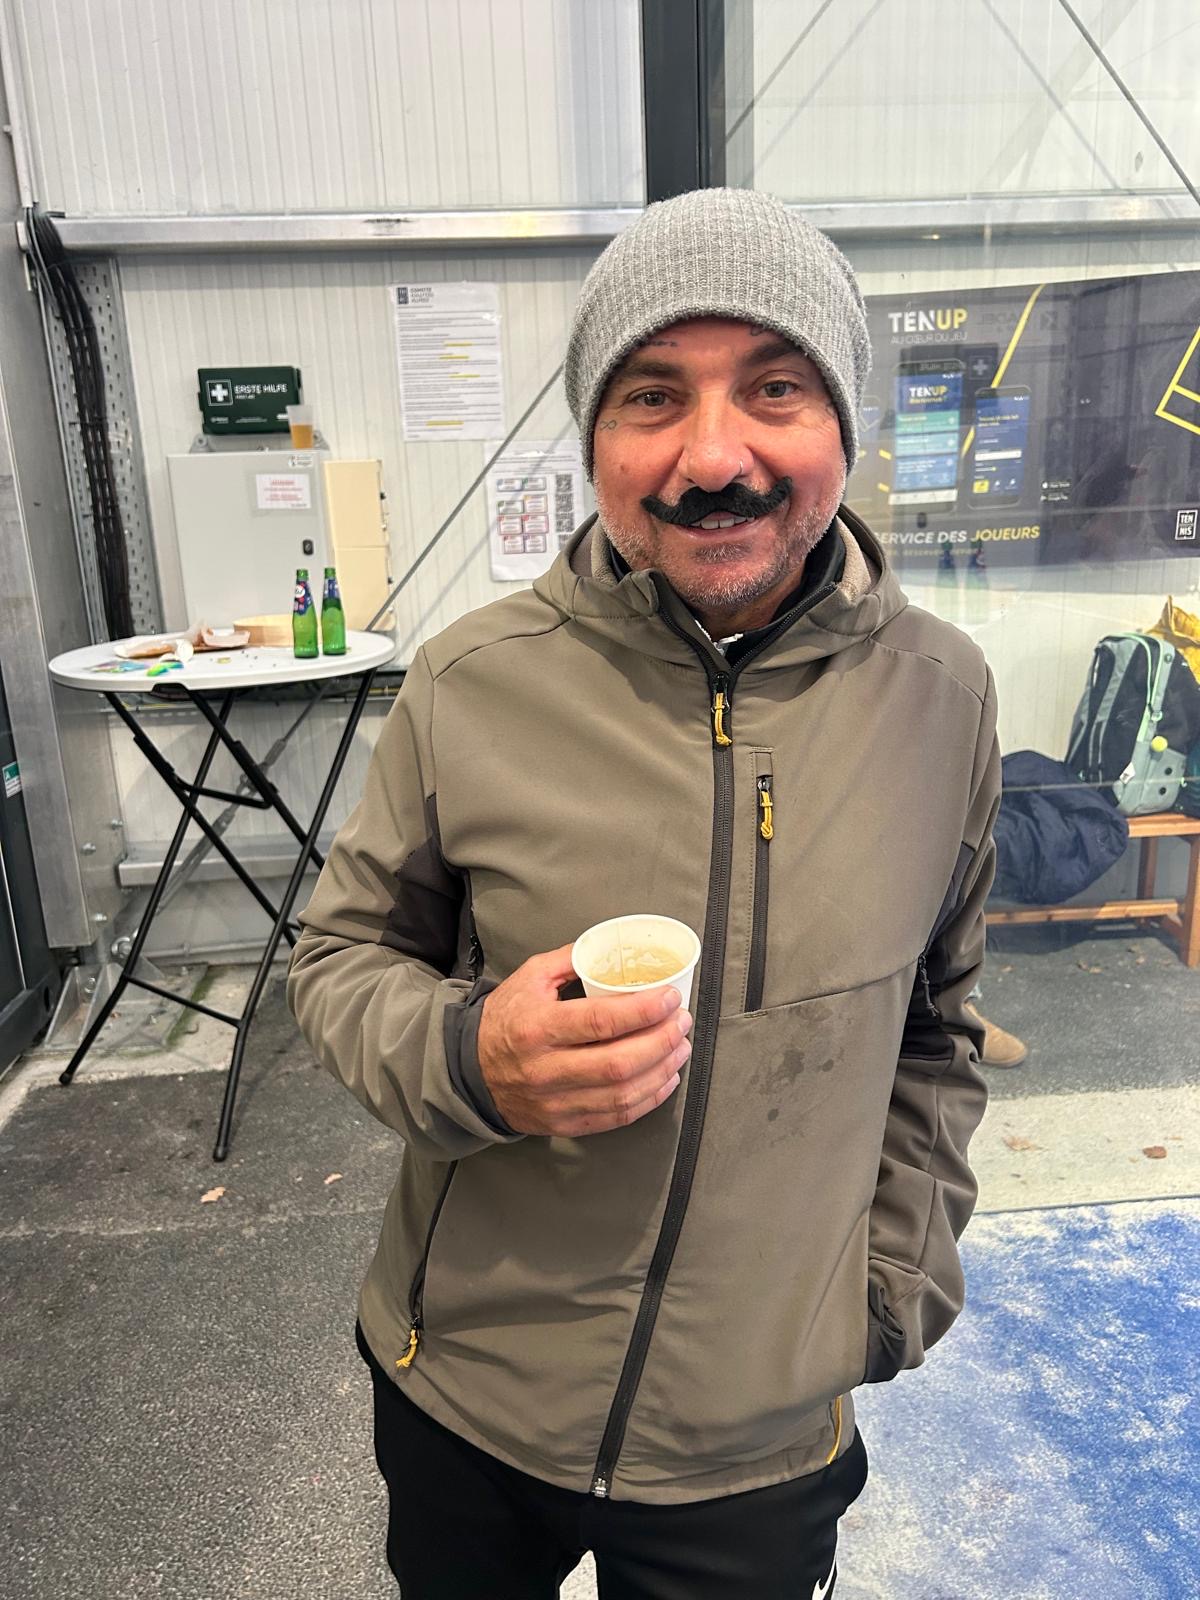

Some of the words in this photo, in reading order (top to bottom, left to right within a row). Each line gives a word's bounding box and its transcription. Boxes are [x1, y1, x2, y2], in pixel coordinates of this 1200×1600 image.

[234, 384, 261, 394] ERSTE
[263, 383, 288, 393] HILFE
[1180, 514, 1194, 524] TEN
[937, 530, 968, 544] DES
[970, 525, 1041, 543] JOUEURS
[1179, 526, 1192, 536] NIS
